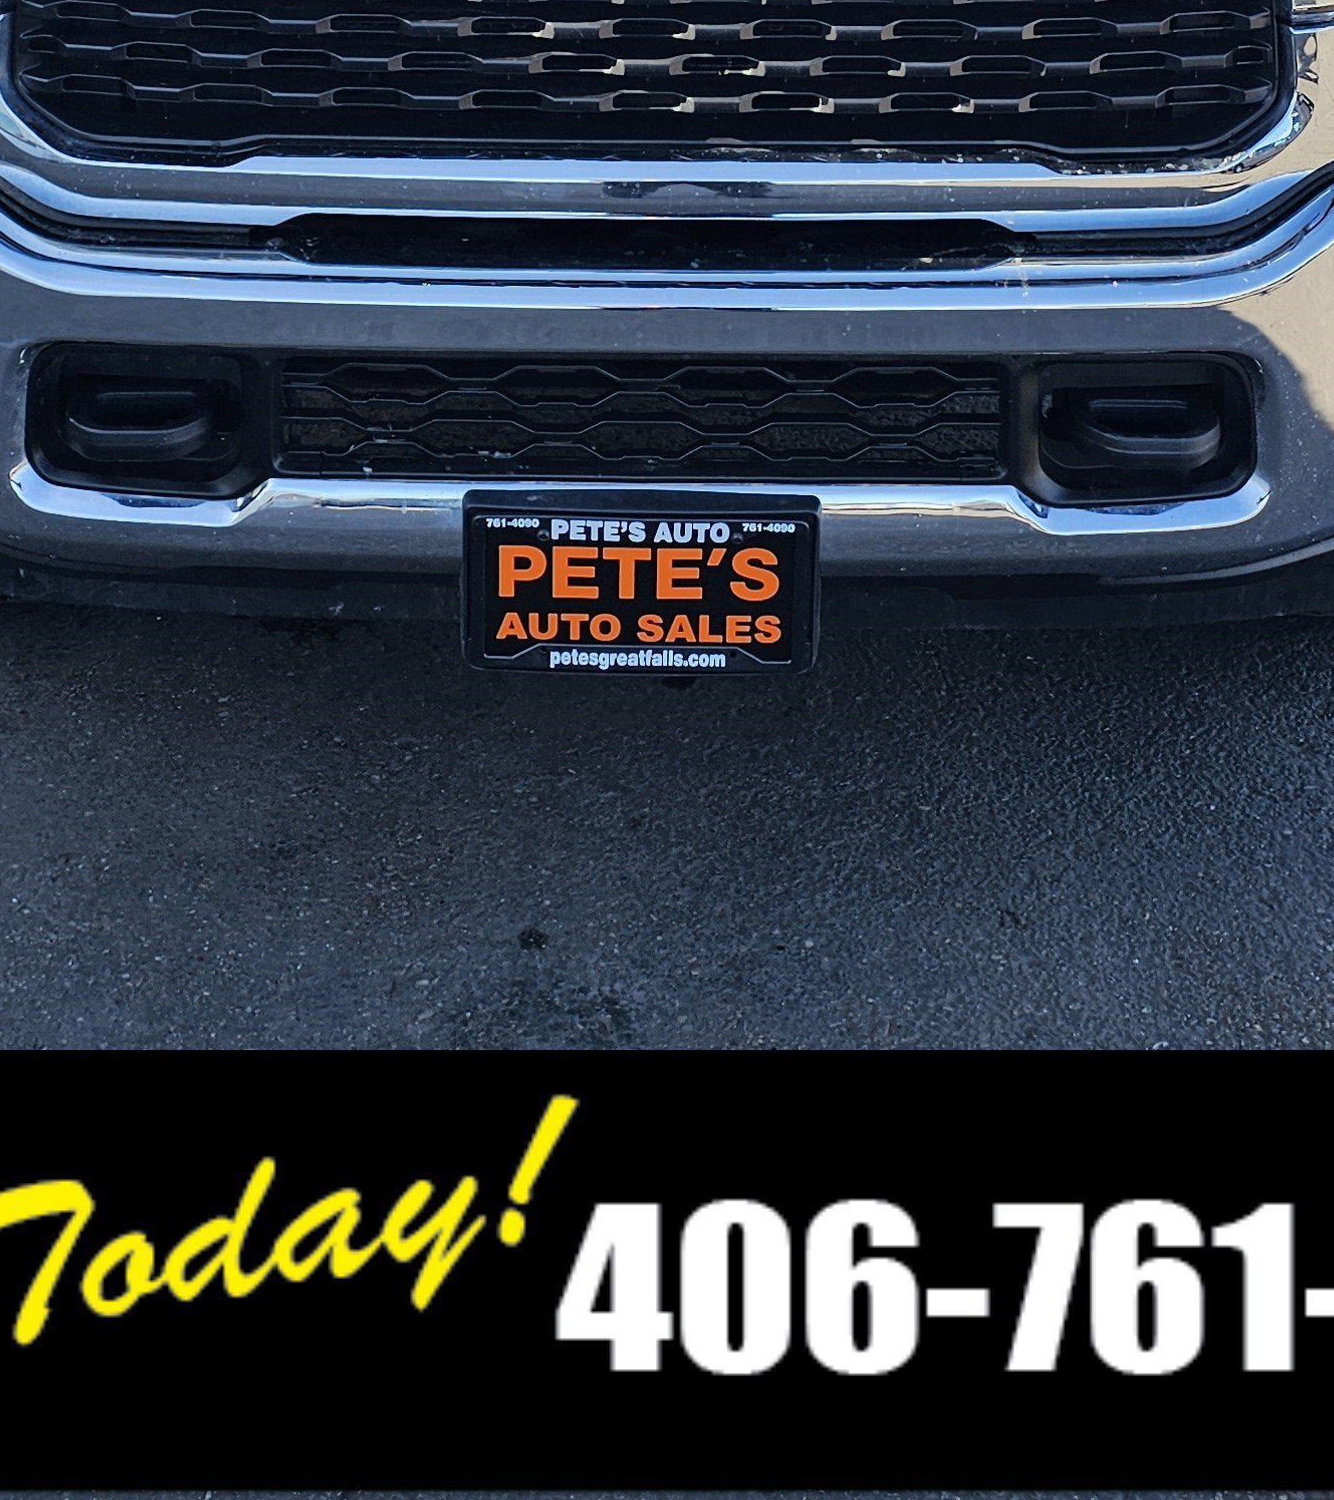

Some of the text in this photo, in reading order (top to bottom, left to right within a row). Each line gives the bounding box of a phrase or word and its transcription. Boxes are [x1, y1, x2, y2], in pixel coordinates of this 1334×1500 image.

[485, 517, 541, 529] 761-4090
[550, 518, 731, 545] PETE'S AUTO
[497, 544, 781, 602] PETE'S
[495, 612, 783, 645] AUTO SALES
[548, 648, 727, 671] petesgreatfalls.com
